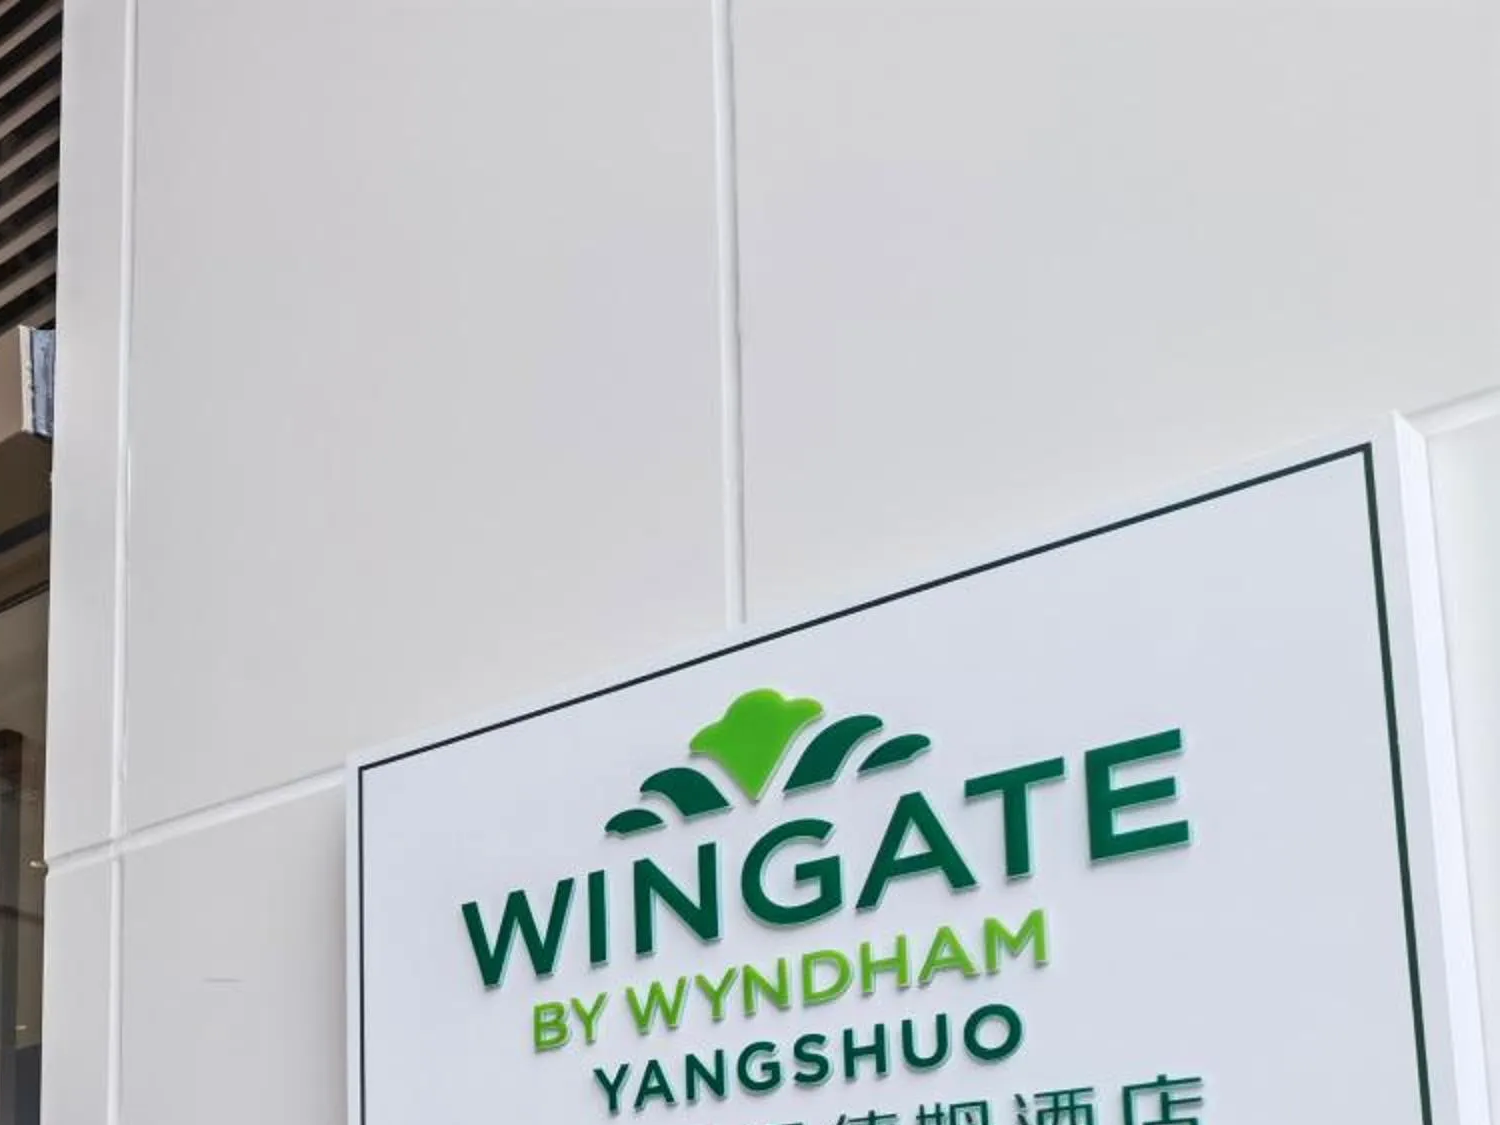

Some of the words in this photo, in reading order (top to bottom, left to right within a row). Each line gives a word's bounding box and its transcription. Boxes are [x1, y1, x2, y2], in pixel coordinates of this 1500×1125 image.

[461, 728, 1192, 991] WINGATE
[533, 992, 608, 1052] BY
[625, 908, 1048, 1036] WYNDHAM
[594, 1003, 1024, 1115] YANGSHUO
